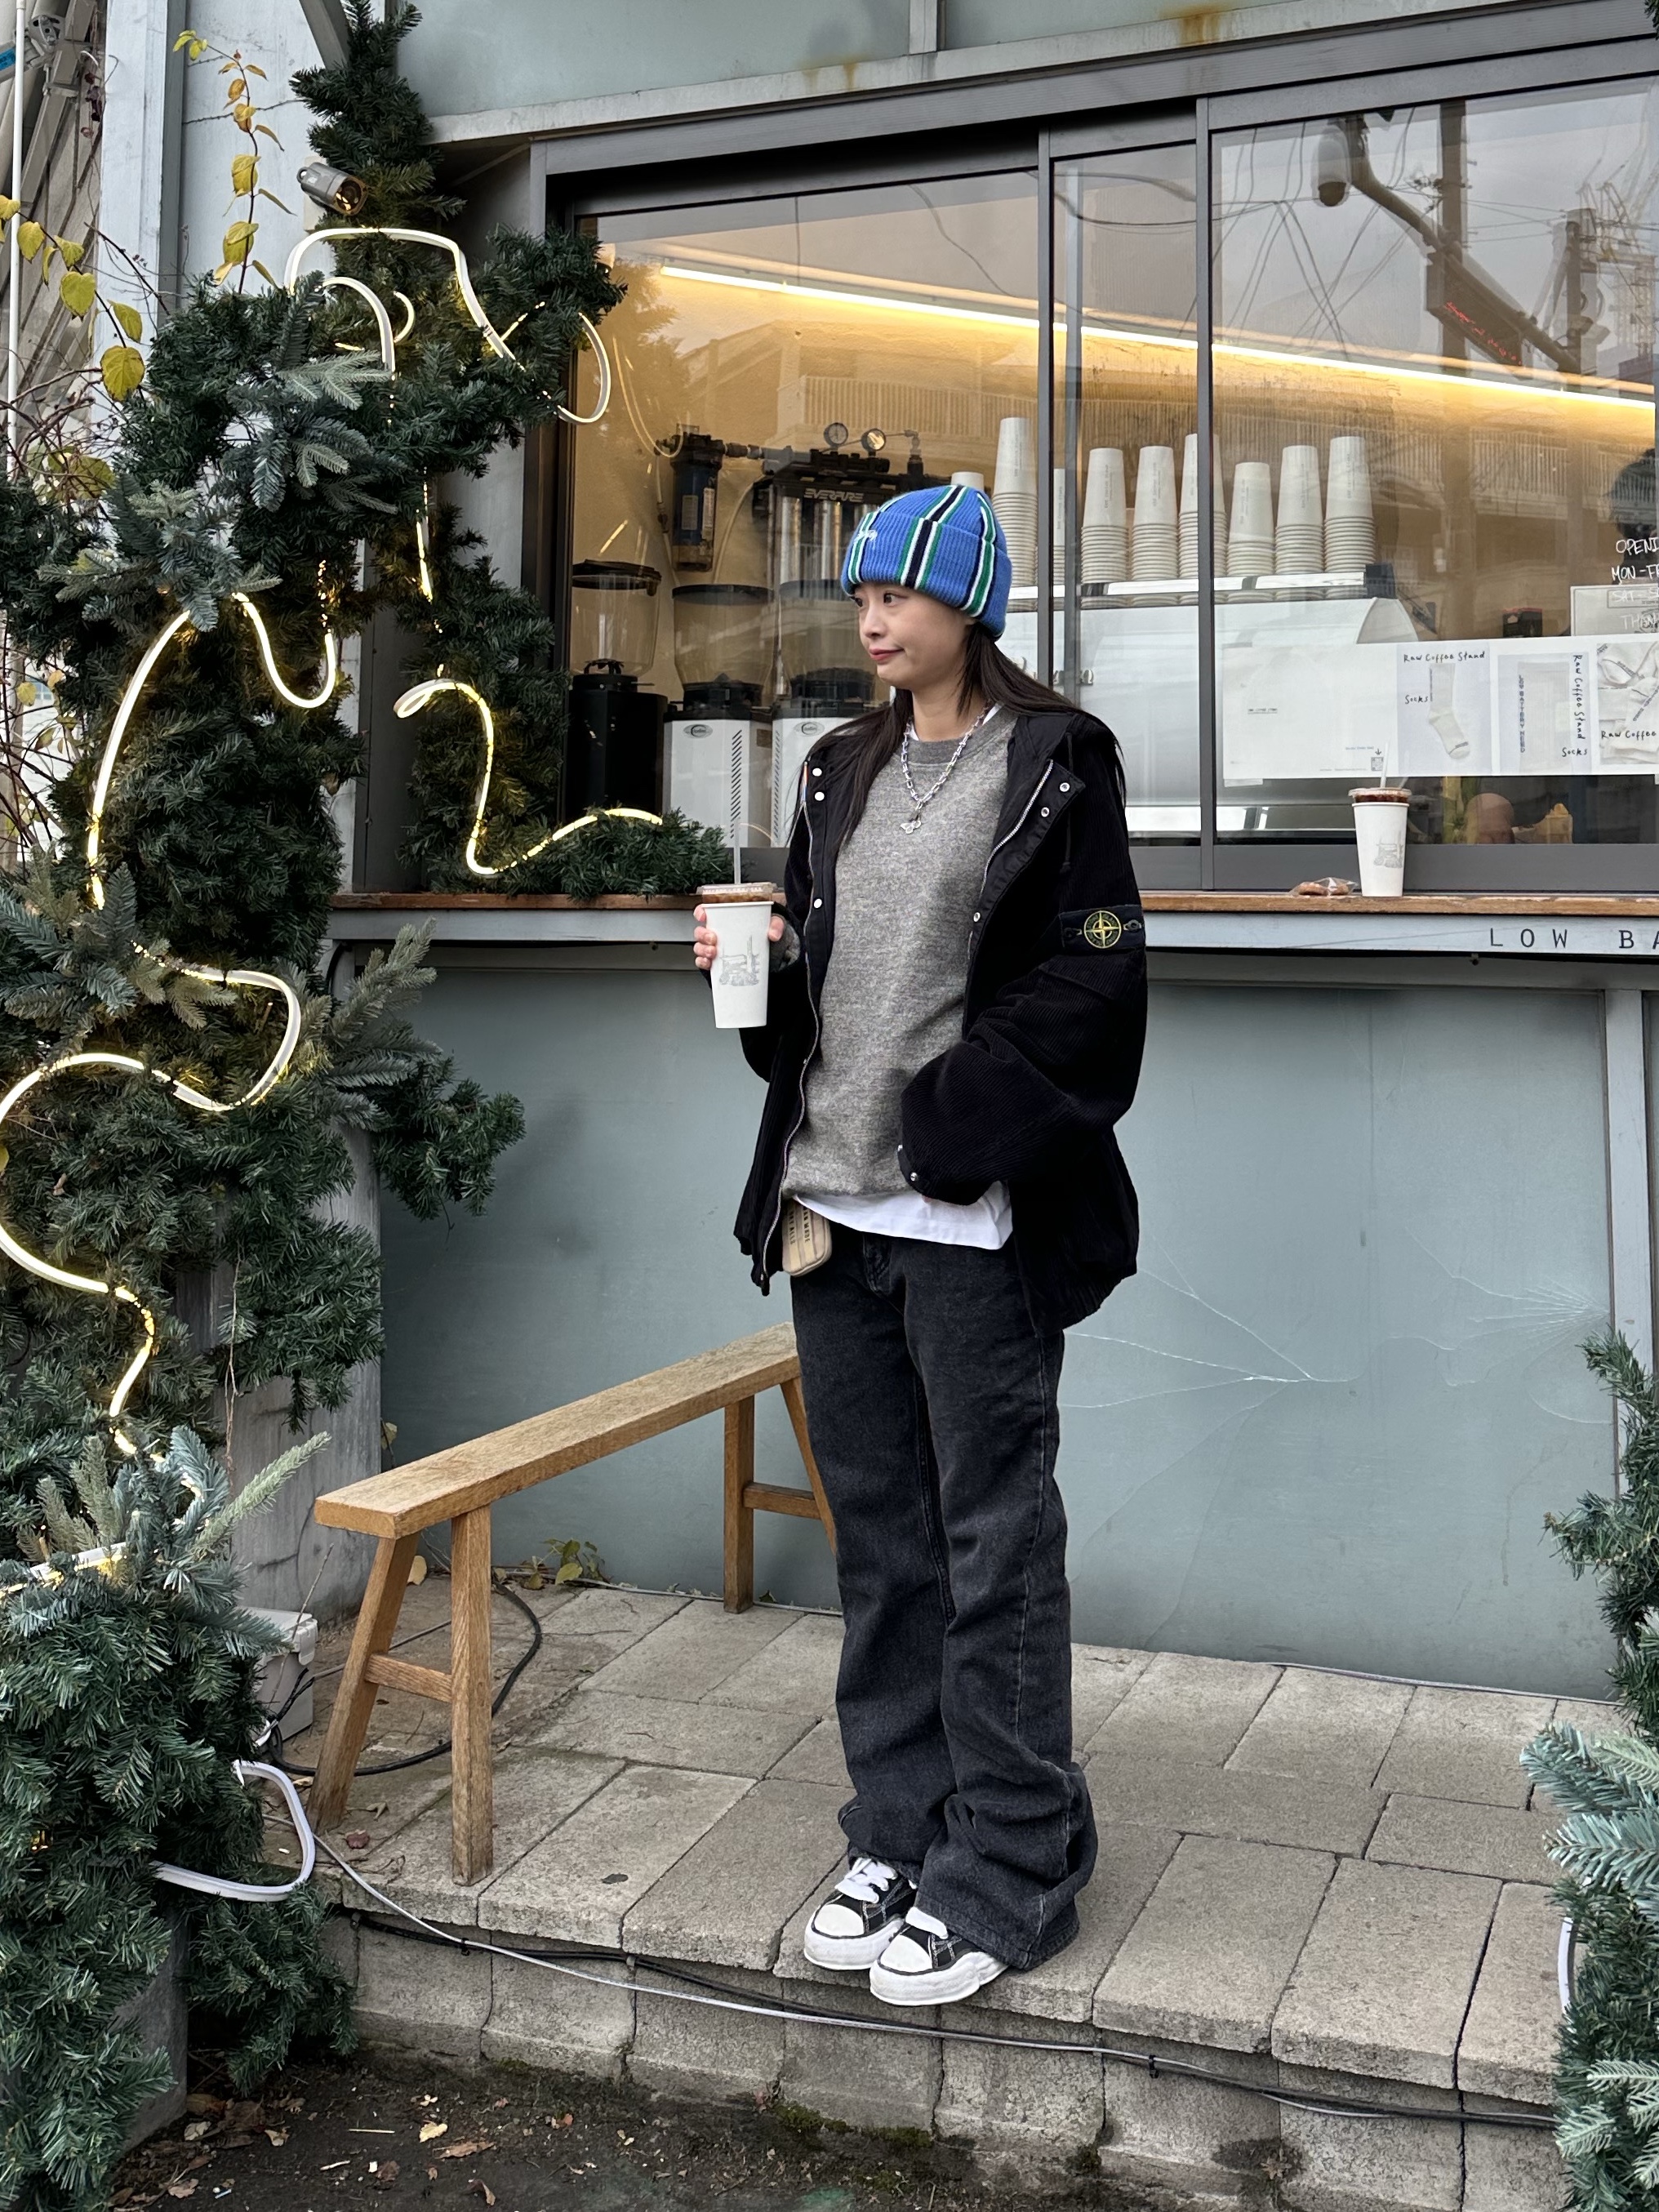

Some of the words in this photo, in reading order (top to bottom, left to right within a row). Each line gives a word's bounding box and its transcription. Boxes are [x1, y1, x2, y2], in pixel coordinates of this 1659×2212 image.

[803, 487, 865, 503] EVERPURE
[1403, 654, 1423, 663] Raw
[1425, 653, 1455, 664] Coffee
[1457, 651, 1485, 662] Stand
[1572, 654, 1583, 674] Raw
[1404, 694, 1429, 705] Socks
[1572, 677, 1583, 708] Coffee
[1573, 711, 1586, 740] Stand
[1600, 730, 1622, 741] Raw
[1625, 730, 1657, 741] Coffee
[1561, 746, 1588, 758] Socks
[1490, 928, 1568, 949] LOW
